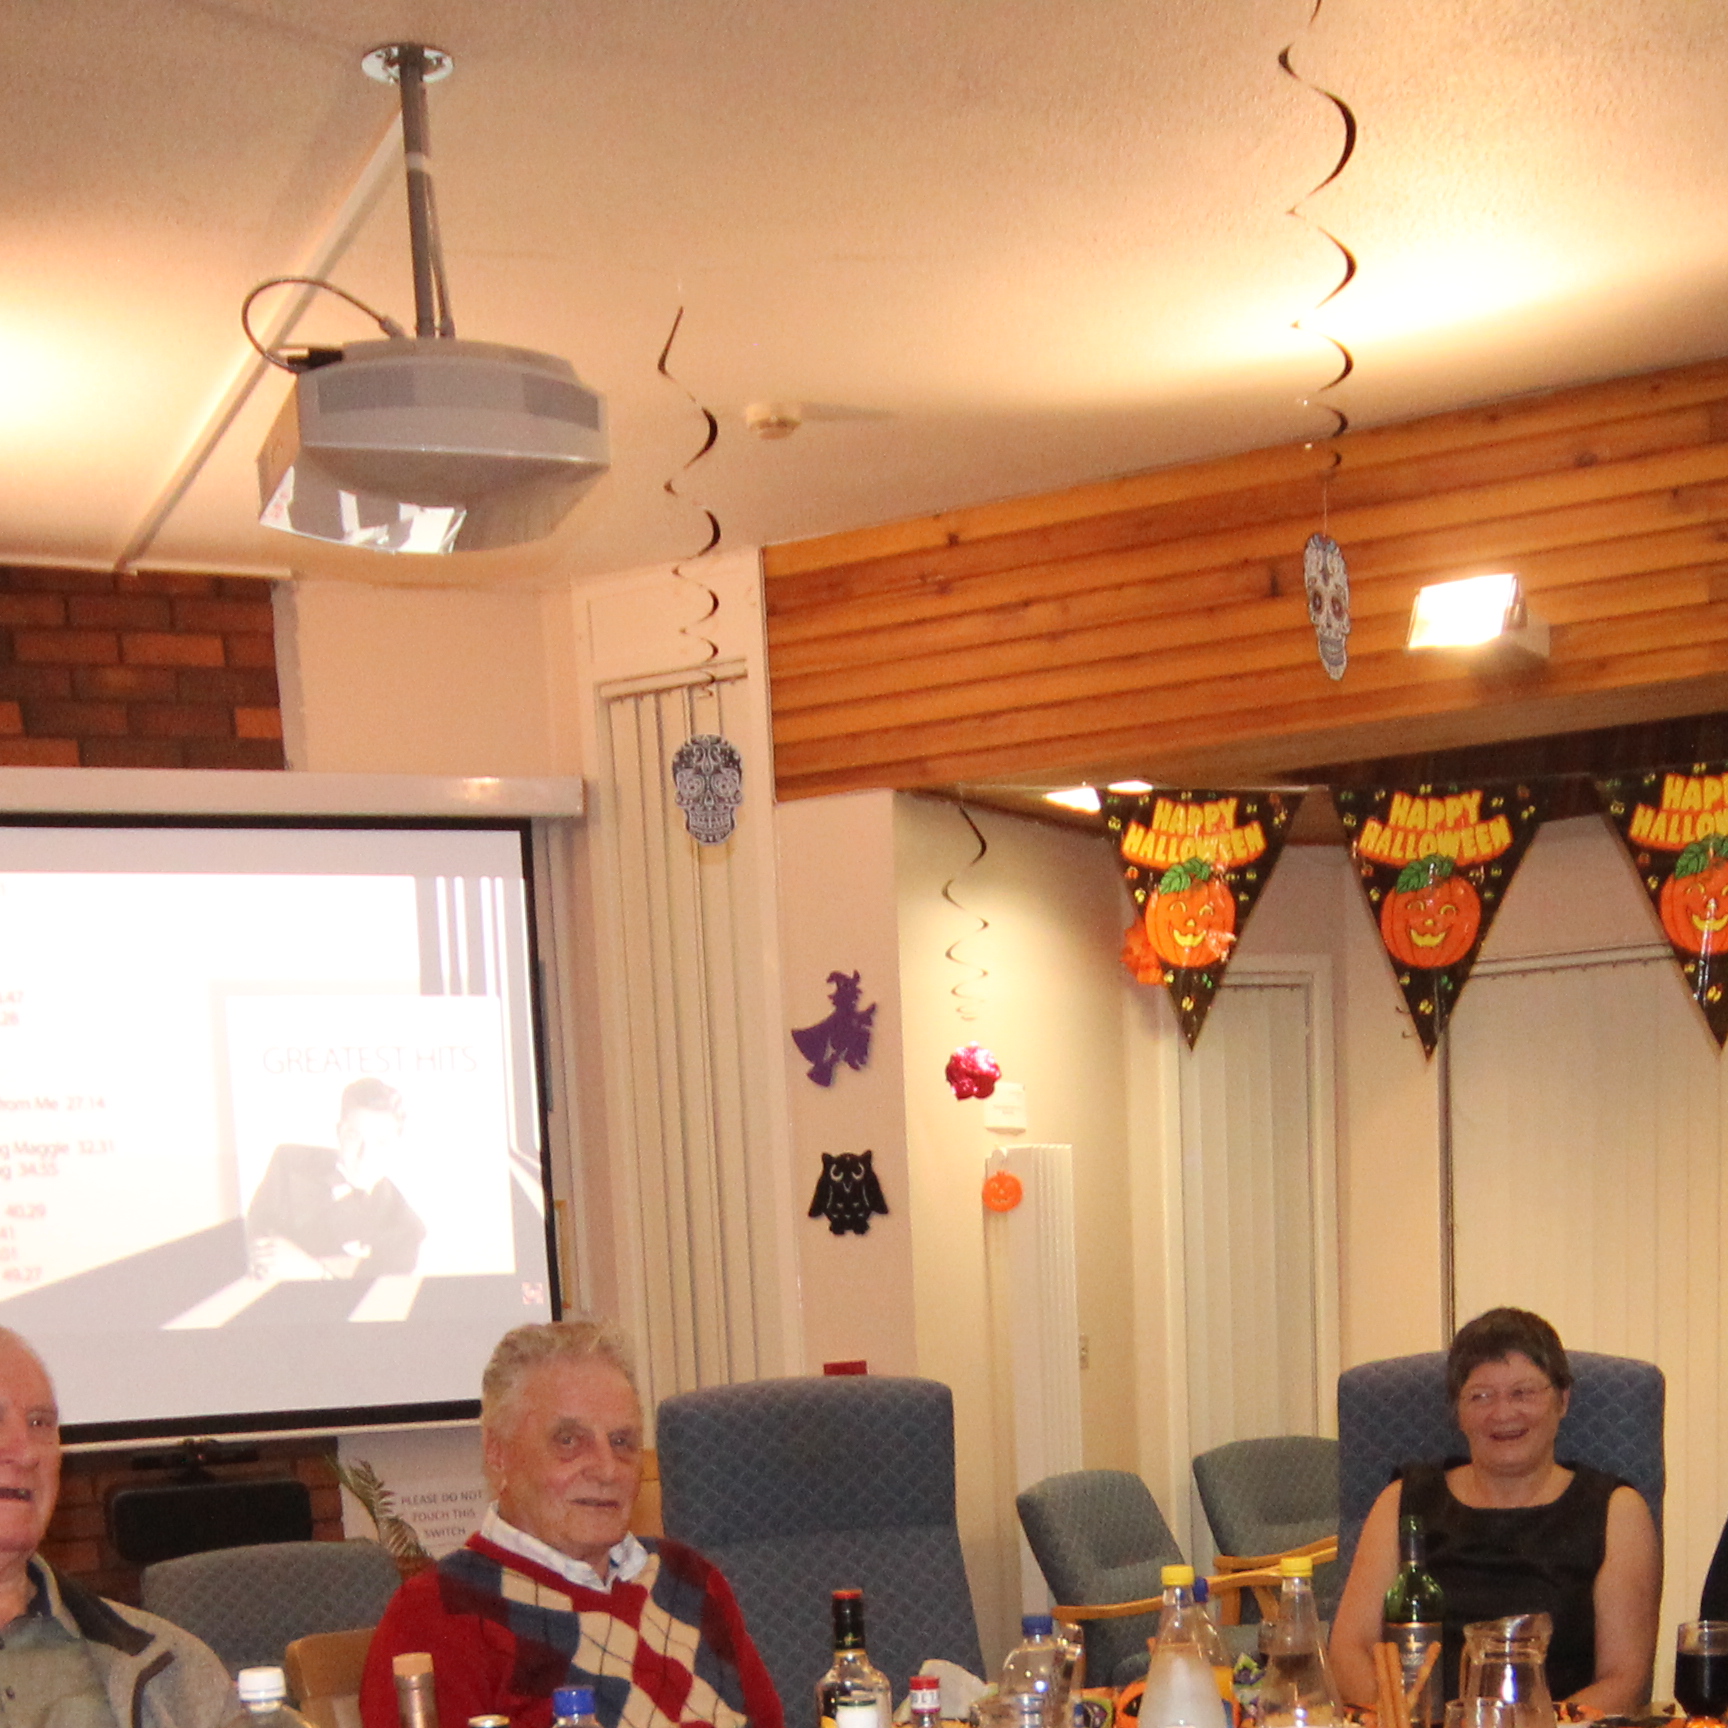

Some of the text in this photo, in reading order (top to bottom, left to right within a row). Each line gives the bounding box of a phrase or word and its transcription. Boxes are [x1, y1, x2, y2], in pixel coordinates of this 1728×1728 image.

[1152, 797, 1238, 834] HAPPY
[1389, 791, 1482, 830] HAPPY
[1122, 822, 1266, 863] HALLOWEEN
[1359, 815, 1512, 860] HALLOWEEN
[262, 1045, 478, 1075] GREATEST HITS
[34, 1096, 58, 1110] Me
[13, 1140, 69, 1160] Maggie
[401, 1490, 482, 1505] PLEASE DO NOT
[412, 1508, 476, 1522] TOUCH THIS
[424, 1527, 466, 1539] SWITCH
